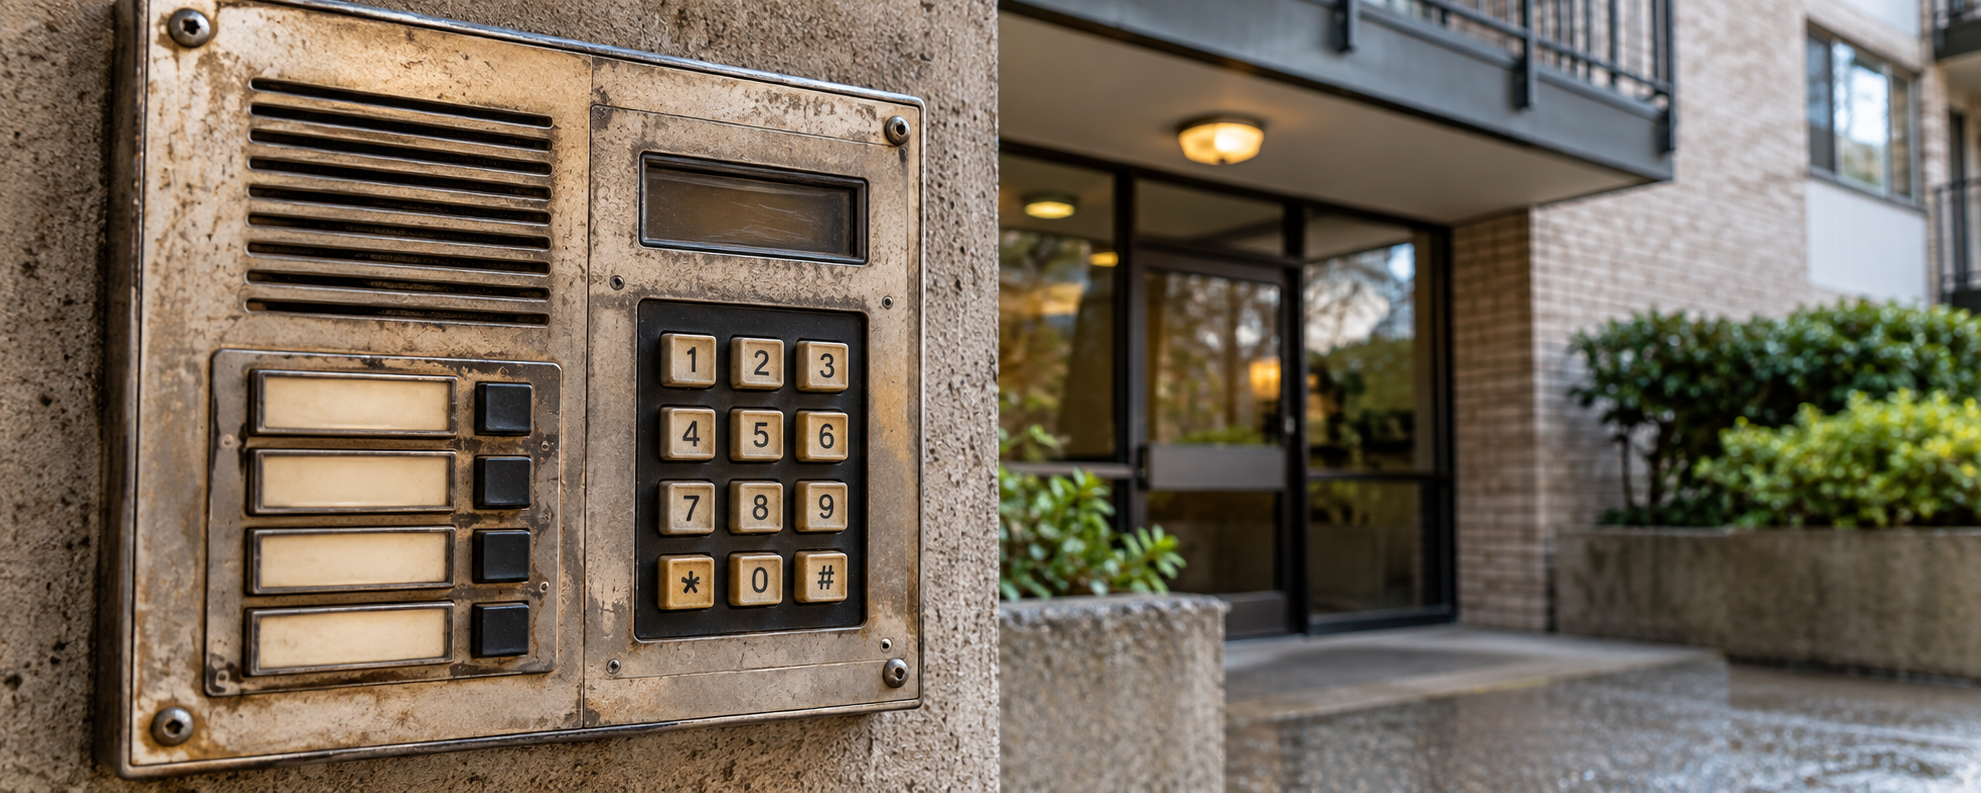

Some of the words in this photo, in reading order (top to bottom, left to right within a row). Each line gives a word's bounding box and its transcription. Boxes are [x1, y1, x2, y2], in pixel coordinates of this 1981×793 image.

[686, 347, 697, 373] 1
[753, 350, 770, 376] 2
[819, 353, 835, 379] 3
[682, 420, 701, 447] 4
[753, 422, 769, 448] 5
[818, 423, 835, 449] 6
[683, 495, 700, 522] 7
[752, 494, 769, 521] 8
[818, 494, 835, 520] 9
[751, 566, 769, 593] 0
[817, 565, 835, 590] #
